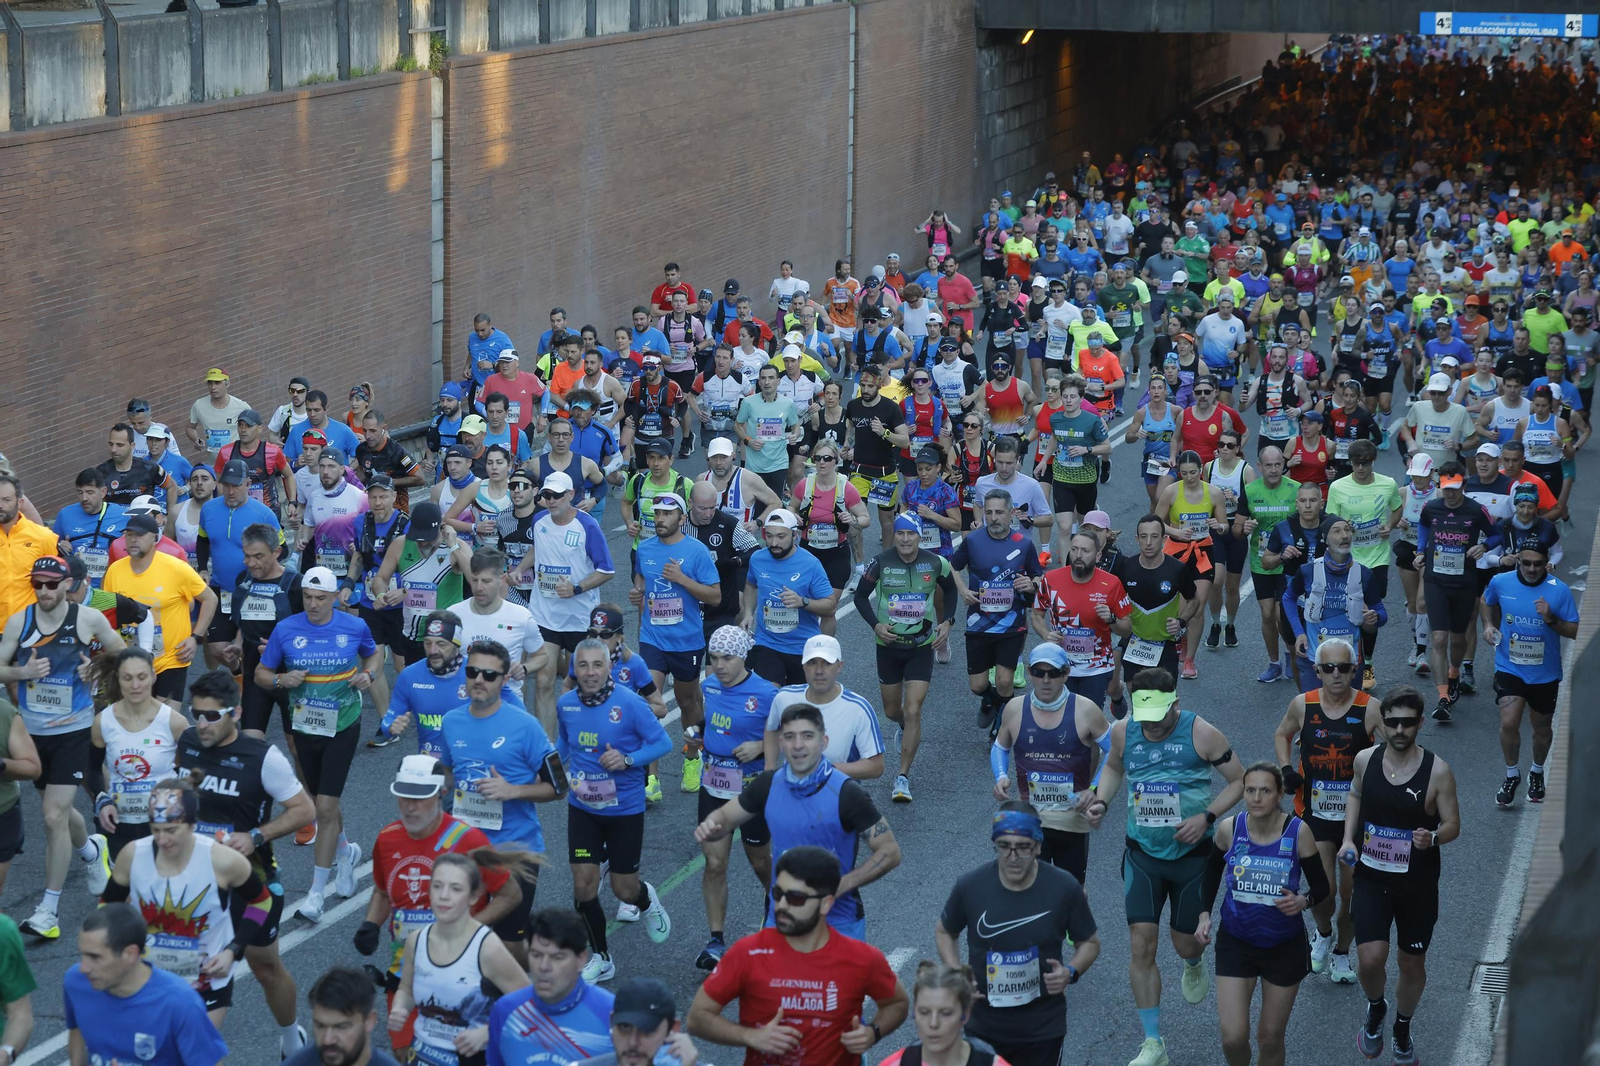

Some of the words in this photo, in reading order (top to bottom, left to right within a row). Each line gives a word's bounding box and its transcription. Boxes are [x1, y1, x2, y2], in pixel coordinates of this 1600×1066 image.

[1459, 26, 1506, 35] DELEGACIÓN
[1507, 27, 1518, 35] DE
[1519, 28, 1558, 36] MOVILIDAD
[1355, 535, 1370, 543] JUAN
[1435, 531, 1470, 542] MADRID
[254, 584, 276, 592] ZURICH
[247, 603, 268, 611] MANU
[410, 599, 427, 608] DANI
[654, 608, 684, 618] MARTINS
[895, 609, 921, 618] SERGIO
[1514, 615, 1545, 626] DALEP
[1066, 644, 1086, 653] GASO
[1130, 648, 1156, 661] COSQUI
[293, 658, 348, 668] MONTEMAR
[41, 676, 68, 685] ZURICH
[412, 682, 435, 690] macron
[36, 694, 61, 706] DAVID
[308, 700, 335, 709] ZURICH
[302, 716, 327, 728] JOTIS
[711, 712, 732, 730] ALDO
[578, 731, 599, 747] CRIS
[119, 748, 146, 757] PASSO
[1024, 751, 1055, 759] PÉGATE
[126, 783, 152, 792] ZURICH
[710, 777, 731, 790] ALDO
[1326, 782, 1351, 791] ZURICH
[1146, 785, 1174, 793] ZURICH
[583, 793, 604, 801] CRIS
[1033, 793, 1068, 803] MARTOS
[1325, 794, 1343, 802] 10701
[1138, 807, 1176, 817] JUANMA
[1378, 830, 1408, 839] ZURICH
[1376, 842, 1393, 850] 8445
[1361, 844, 1392, 862] DANIEL
[1393, 852, 1410, 864] MN
[1253, 859, 1284, 869] ZURICH
[1250, 872, 1272, 882] 14770
[1237, 880, 1284, 896] DELARUE
[158, 938, 192, 948] ZURICH
[1005, 951, 1033, 964] ZURICH
[1005, 970, 1027, 979] 10595
[781, 979, 824, 990] GENERALI
[988, 983, 996, 993] P.
[997, 975, 1042, 994] CARMONA
[781, 995, 825, 1012] MÁLAGA
[422, 1045, 454, 1065] ZURICH
